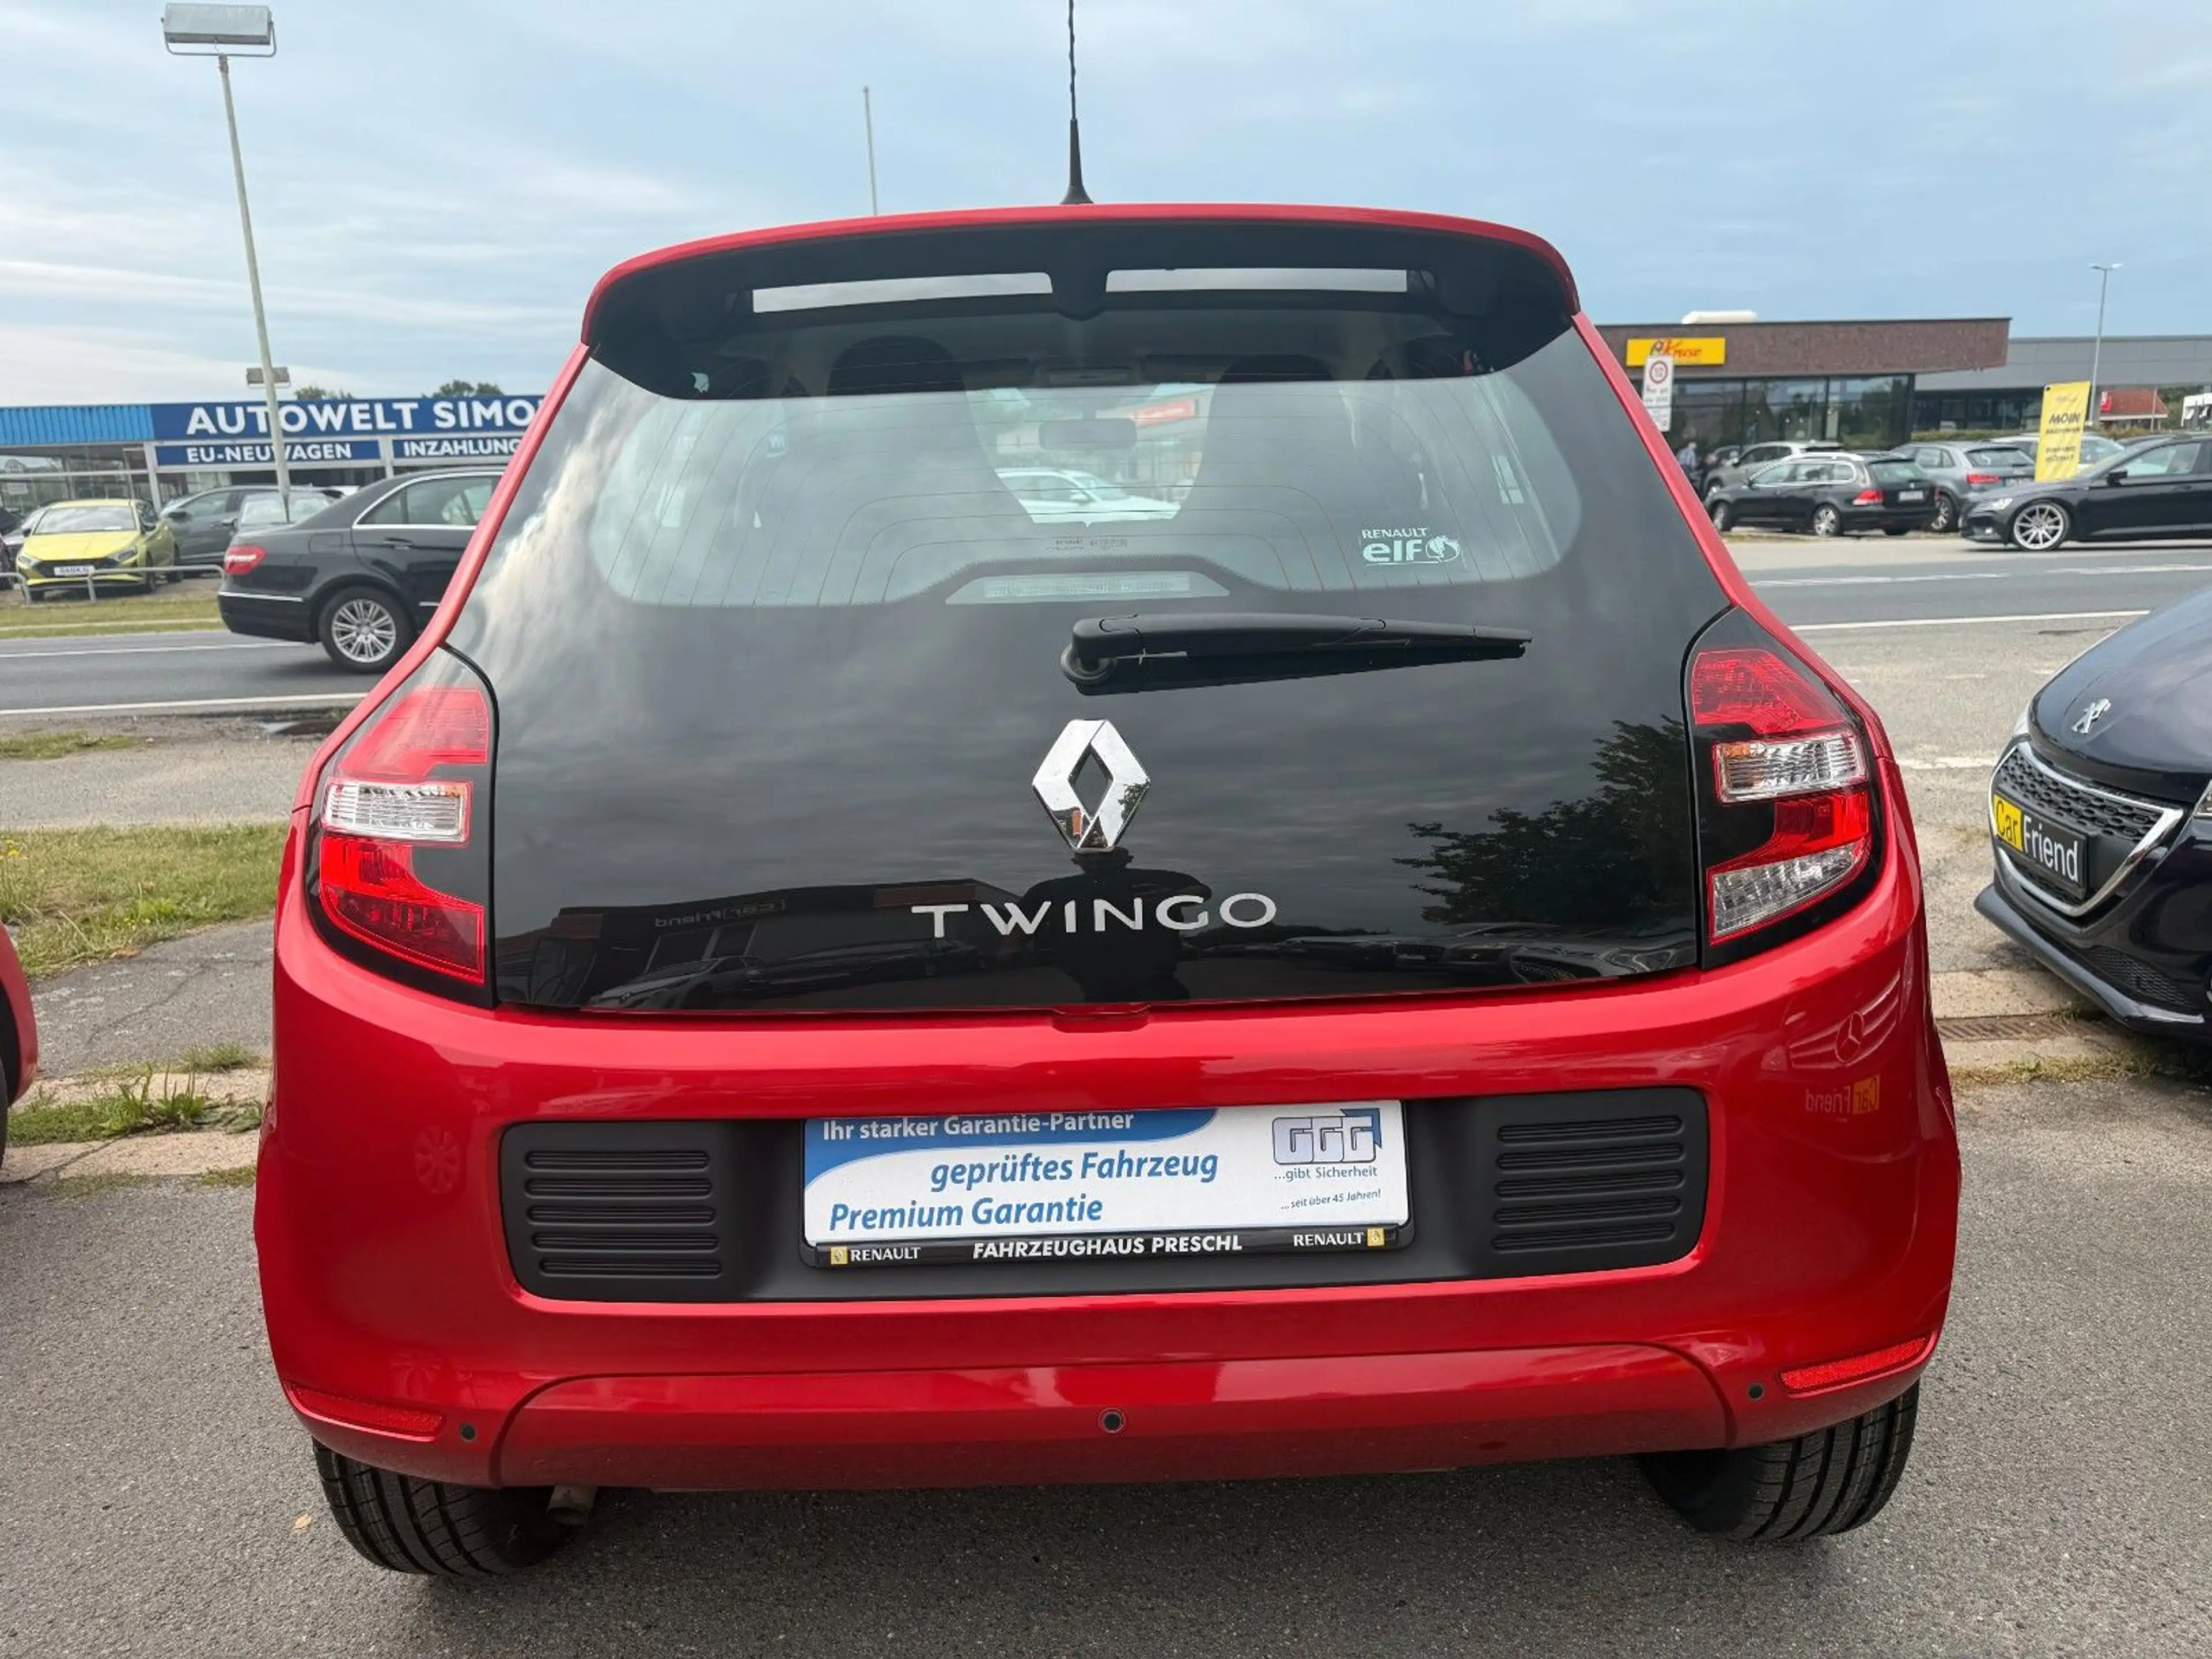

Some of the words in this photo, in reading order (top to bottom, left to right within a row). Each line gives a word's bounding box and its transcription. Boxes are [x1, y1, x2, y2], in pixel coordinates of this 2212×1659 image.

[187, 402, 419, 435] AUTOWELT
[433, 398, 543, 429] SIMO
[1361, 528, 1427, 539] RENAULT
[1363, 539, 1423, 562] elf
[1996, 800, 2018, 845] Car
[2024, 814, 2079, 883] Friend
[911, 892, 1277, 938] TWINGO
[823, 1120, 854, 1141] Ihr
[859, 1117, 938, 1139] starker
[944, 1112, 1135, 1135] Garantie-Partner
[930, 1153, 1073, 1192] geprüftes
[1081, 1150, 1219, 1183] Fahrzeug
[1316, 1165, 1378, 1179] Sicherheit
[830, 1200, 963, 1231] Premium
[972, 1193, 1103, 1225] Garantie
[1291, 1198, 1308, 1208] seit
[1332, 1193, 1344, 1203] 45
[1347, 1188, 1381, 1202] Jahren!
[851, 1247, 921, 1262] RENAULT
[973, 1236, 1145, 1259] FAHRZEUGHAUS
[1152, 1234, 1243, 1253] PRESCHL
[1294, 1232, 1364, 1247] RENAULT
